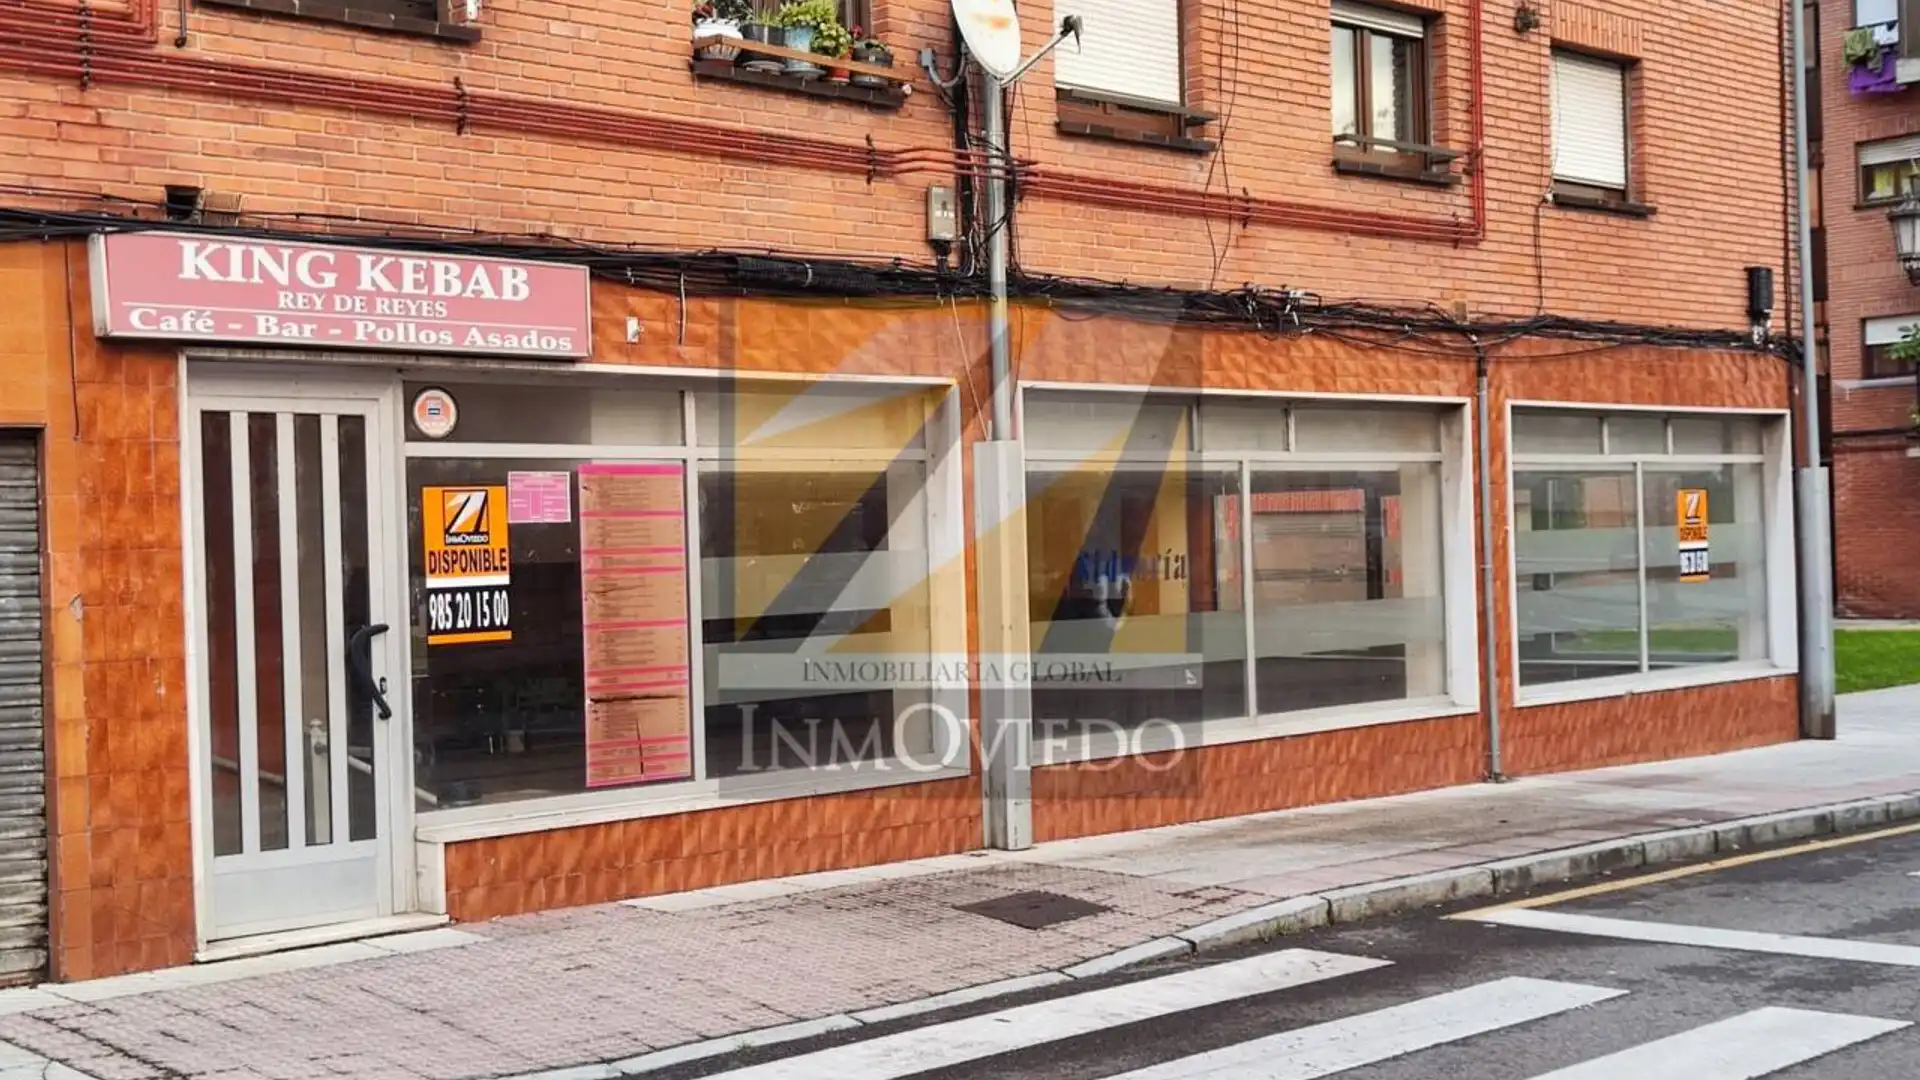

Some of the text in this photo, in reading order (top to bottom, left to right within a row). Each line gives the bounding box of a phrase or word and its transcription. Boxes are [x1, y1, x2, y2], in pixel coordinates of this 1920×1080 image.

[177, 240, 530, 301] KING KEBAB
[278, 291, 448, 318] REY DE REYES
[129, 307, 215, 333] Café
[255, 314, 318, 337] Bar
[353, 320, 454, 345] Pollos
[463, 326, 573, 351] Asados
[428, 548, 507, 575] DISPONIBLE
[429, 590, 509, 631] 985 20 15 00
